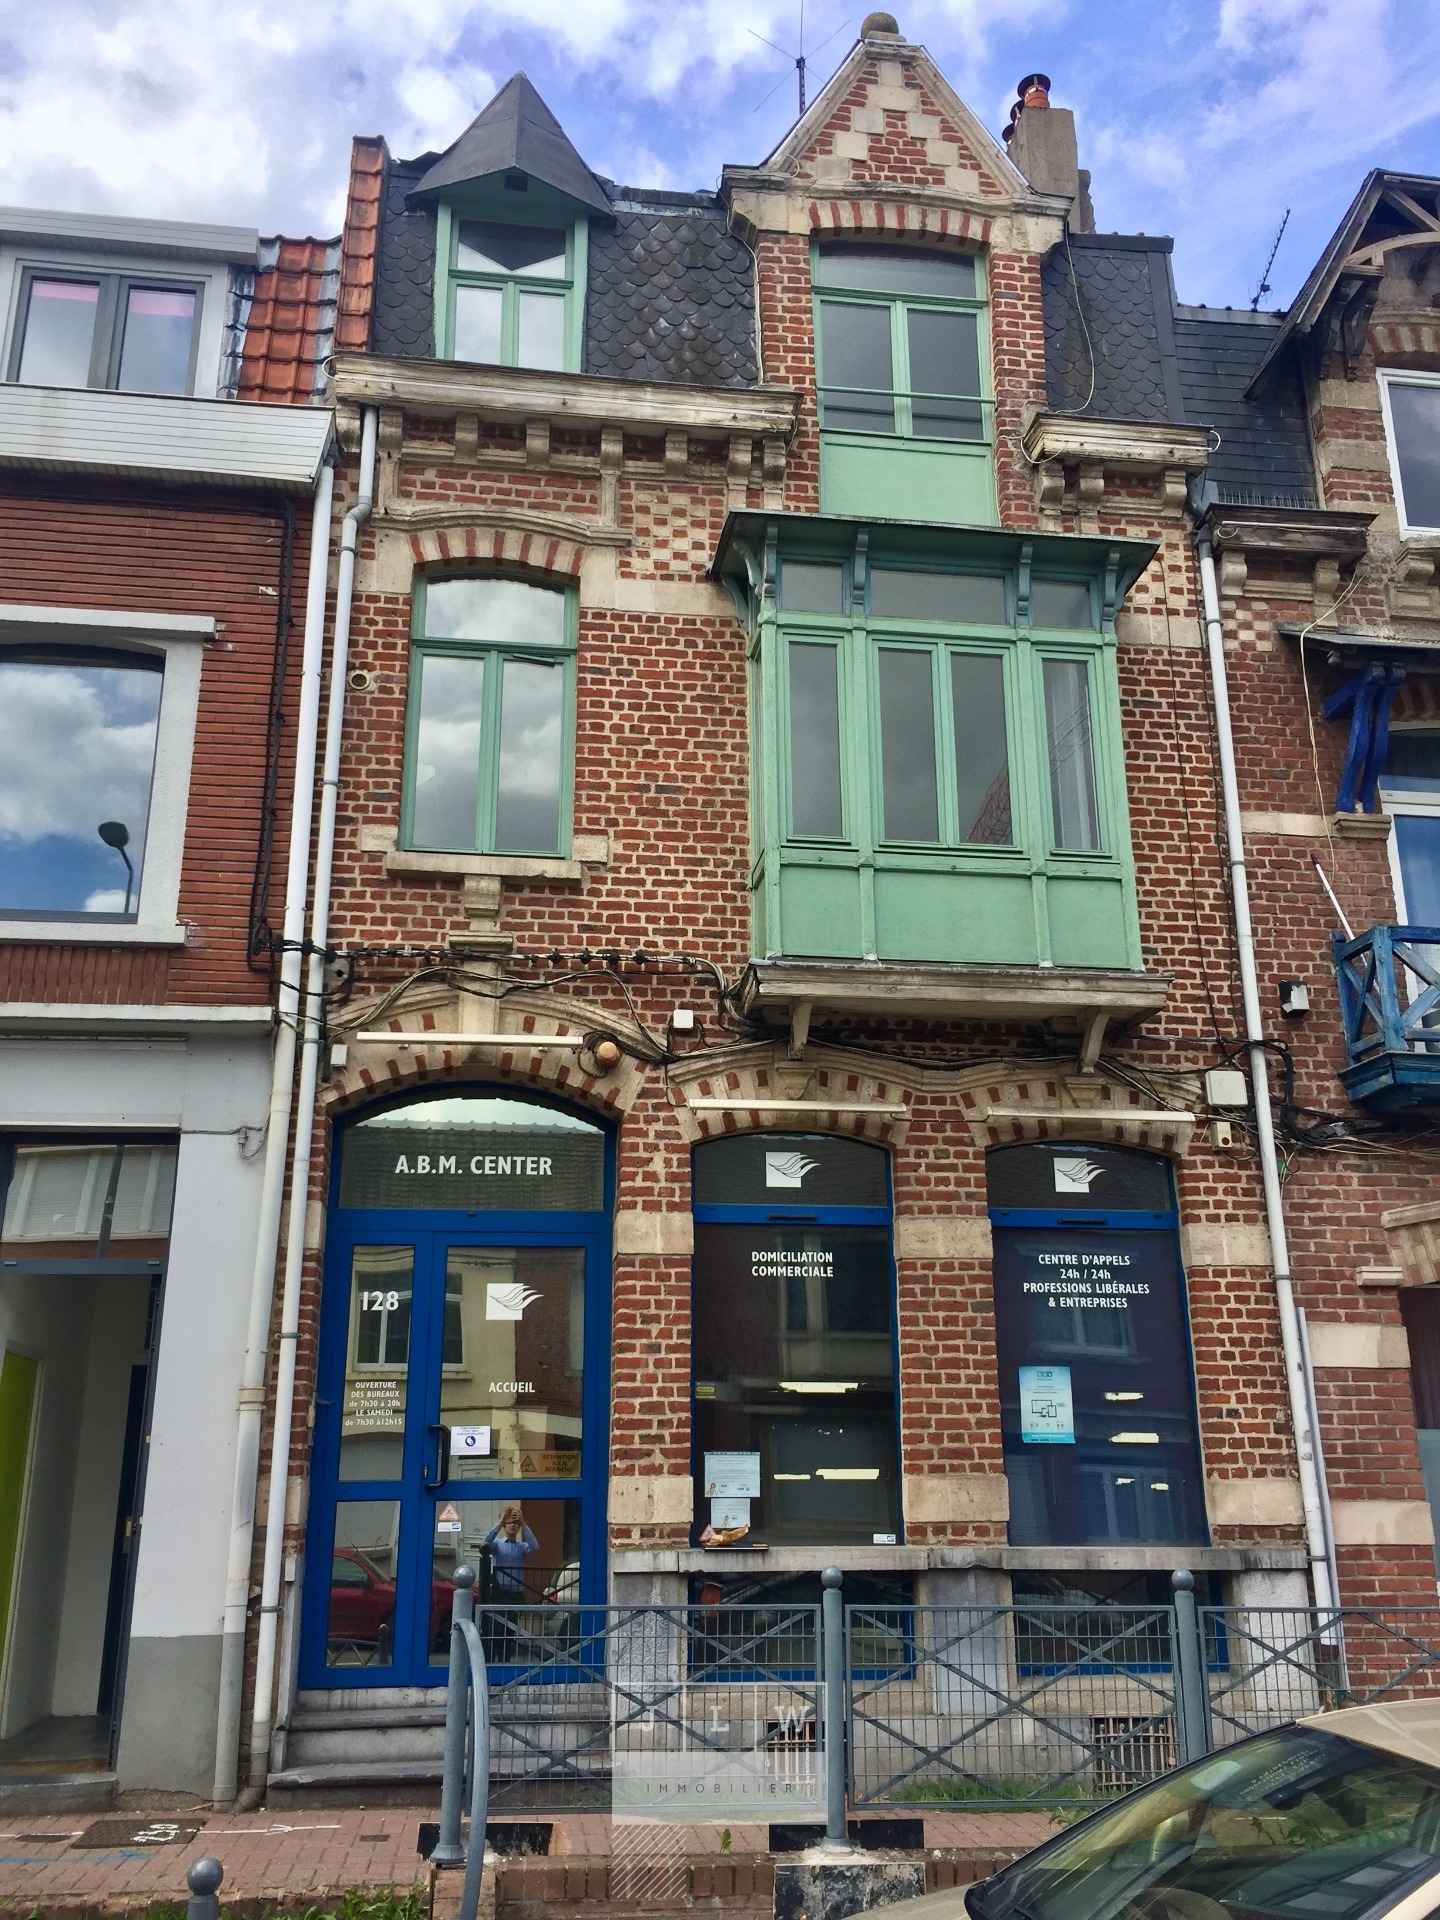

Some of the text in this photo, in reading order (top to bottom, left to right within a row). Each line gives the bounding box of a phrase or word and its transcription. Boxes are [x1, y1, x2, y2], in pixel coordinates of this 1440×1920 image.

[395, 1154, 553, 1176] A.B.M. CENTER
[751, 1251, 833, 1263] DOMICILIATION
[1038, 1254, 1079, 1265] CENTRE
[751, 1265, 834, 1277] COMMERCIALE
[1059, 1269, 1111, 1280] 24h / 24h
[1023, 1280, 1150, 1295] PROFESSIONS LIBÉRALES
[362, 1291, 400, 1311] 128
[1048, 1296, 1128, 1309] & ENTREPRISES
[355, 1381, 397, 1389] OUVERTURE
[488, 1382, 536, 1394] ACCUEIL
[351, 1390, 400, 1398] DES BUREAUX
[355, 1409, 365, 1417] LE
